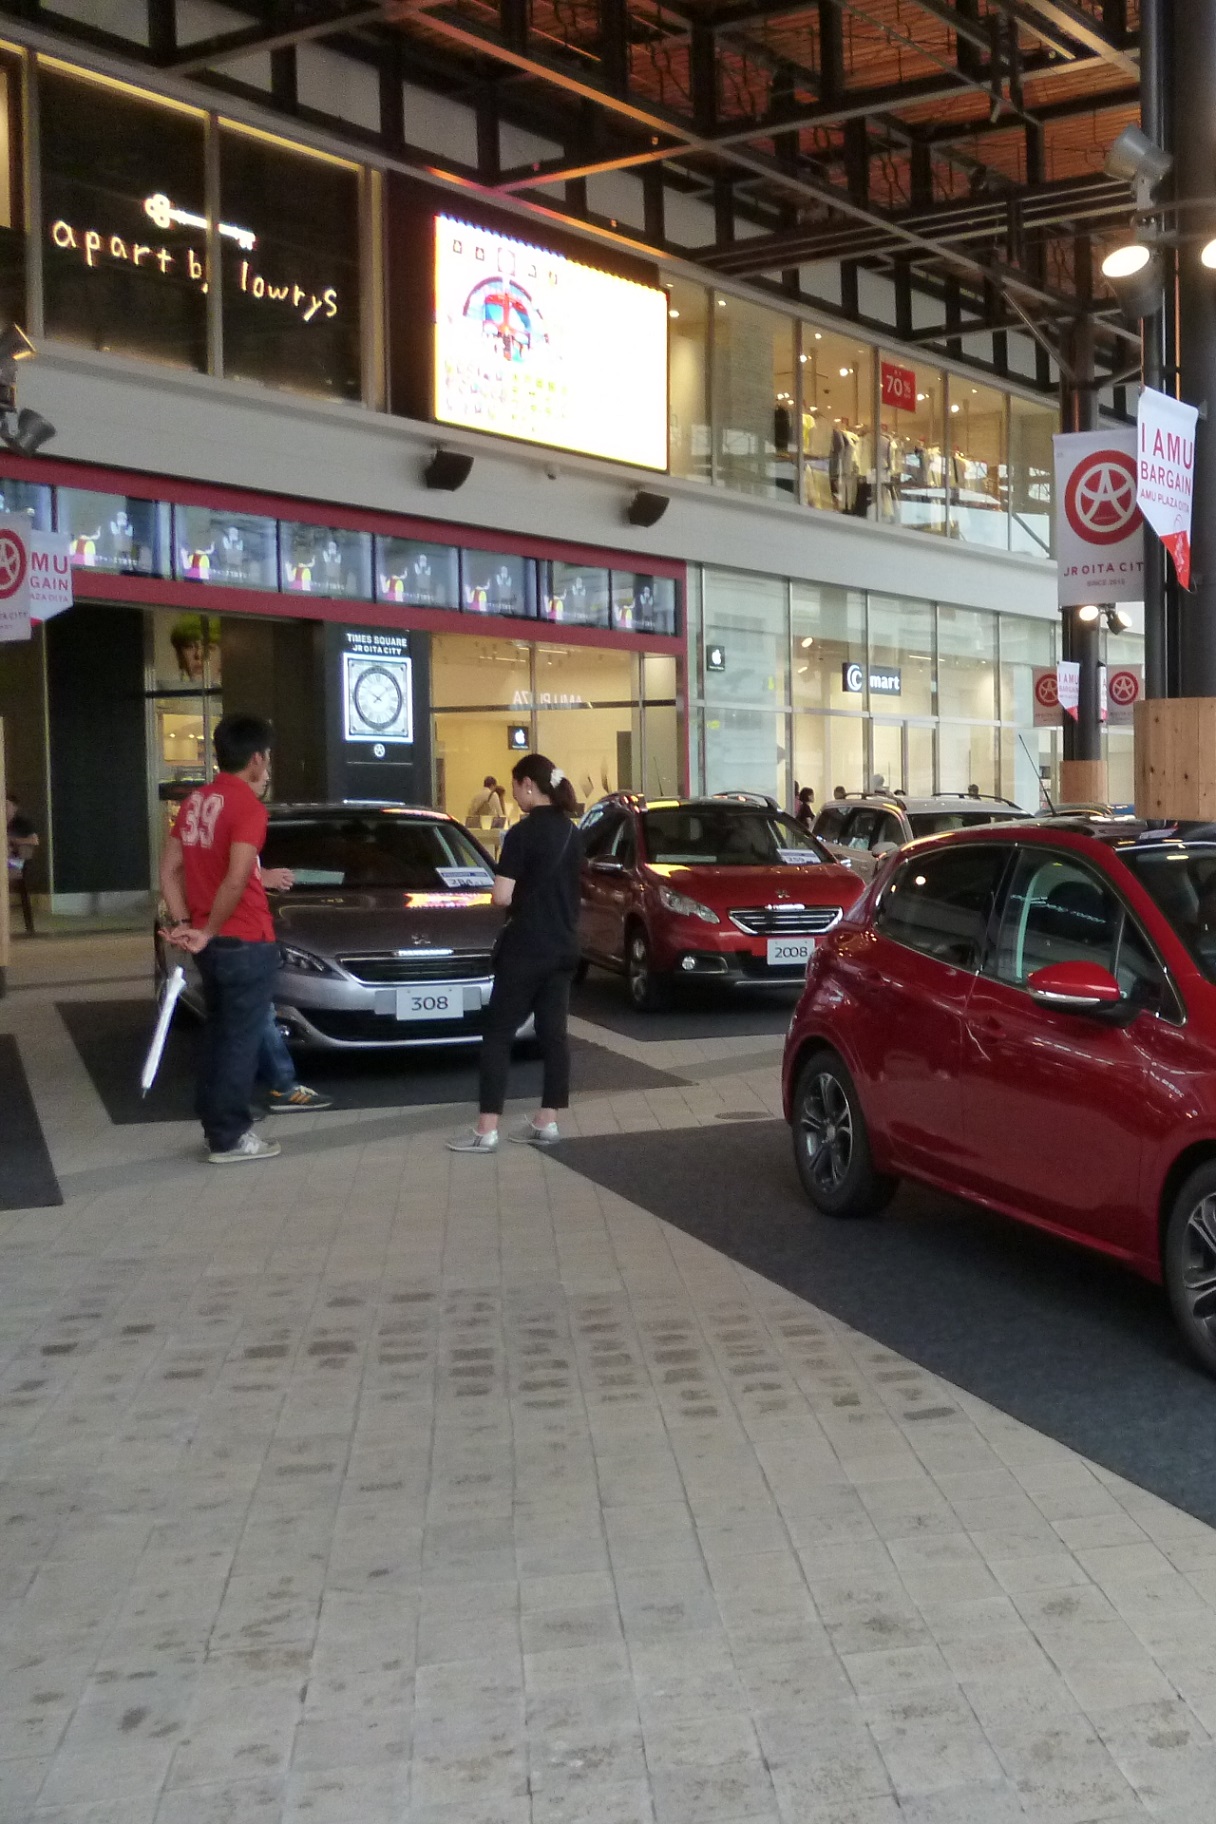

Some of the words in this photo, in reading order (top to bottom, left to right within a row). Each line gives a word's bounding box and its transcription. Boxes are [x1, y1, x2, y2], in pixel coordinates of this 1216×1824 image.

[53, 219, 175, 274] apart
[188, 249, 209, 294] b
[1141, 422, 1145, 453] I
[1152, 427, 1193, 470] AMU
[1140, 459, 1191, 497] BARGAIN
[1140, 487, 1157, 502] AMU
[1157, 492, 1178, 510] PLAZA
[1063, 565, 1079, 577] JR
[1080, 562, 1116, 575] OITA
[346, 632, 373, 644] TIMES
[373, 635, 408, 648] SQUARE
[363, 645, 383, 654] OITA
[382, 647, 402, 656] CITY
[181, 790, 224, 848] 39
[774, 946, 808, 959] 2008
[411, 995, 449, 1011] 308
